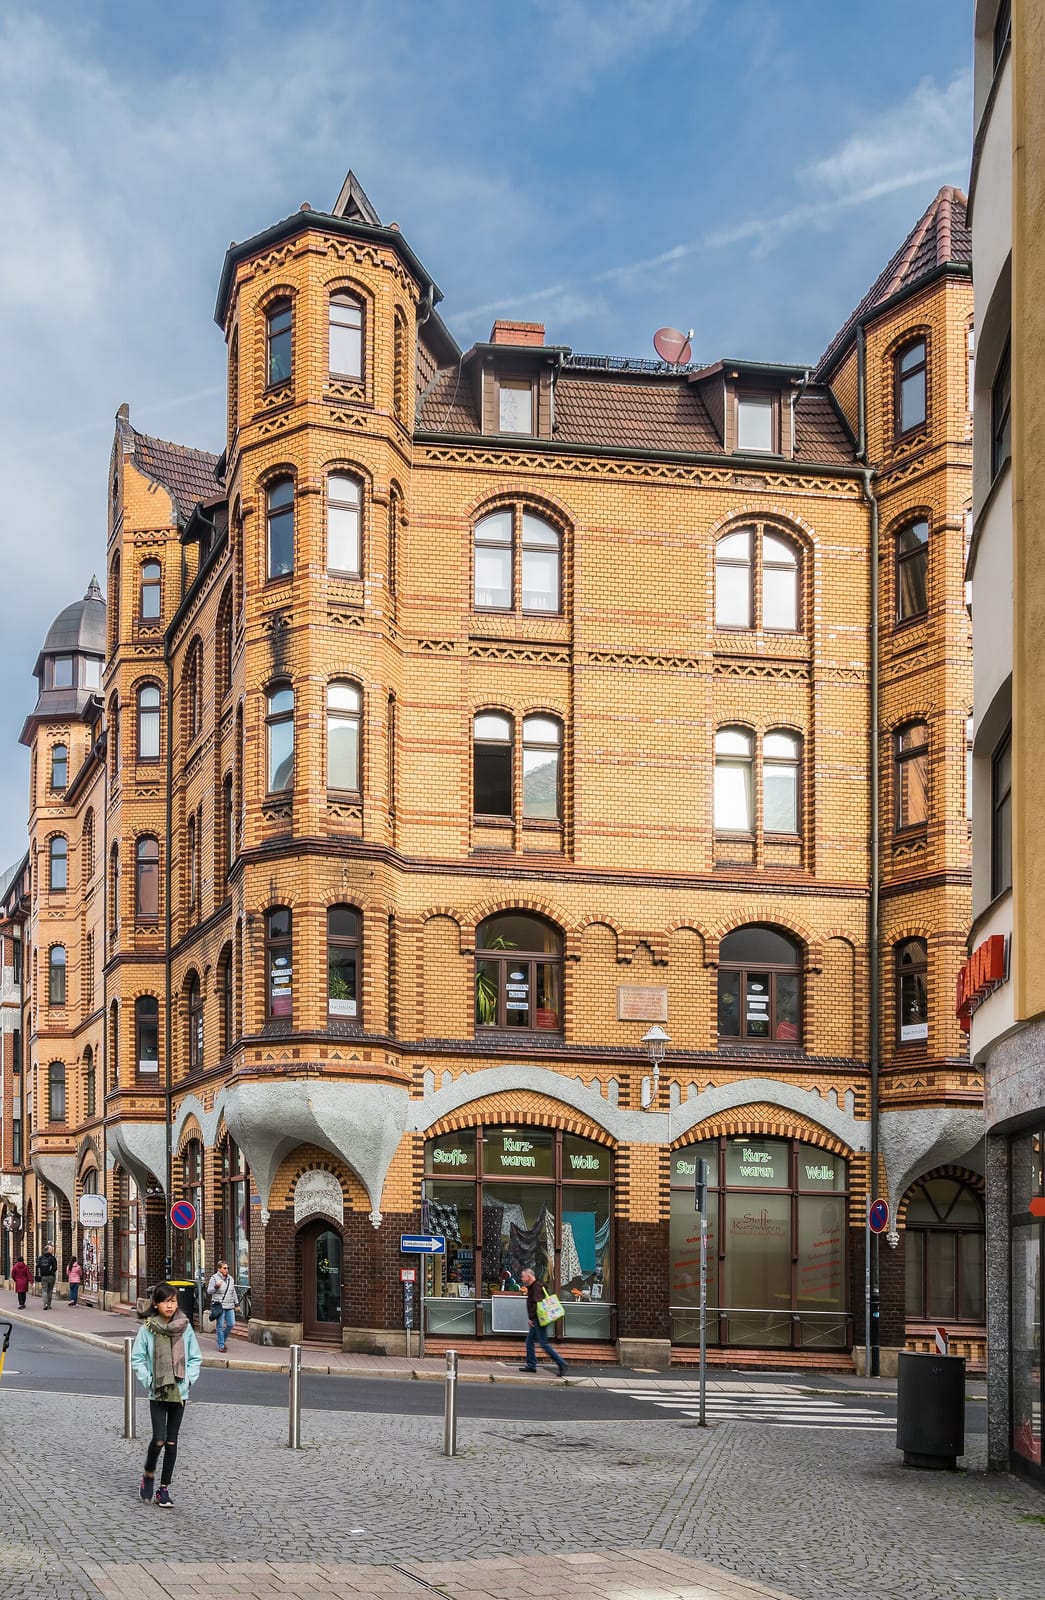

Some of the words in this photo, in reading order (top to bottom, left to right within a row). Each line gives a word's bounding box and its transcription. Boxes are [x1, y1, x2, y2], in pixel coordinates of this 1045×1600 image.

[503, 1137, 534, 1152] Kurz-
[433, 1149, 468, 1166] Stoffe
[500, 1155, 536, 1168] waren
[569, 1154, 600, 1170] Wolle
[742, 1148, 773, 1163] Kurz-
[676, 1160, 710, 1175] Sto
[739, 1166, 774, 1178] waren
[805, 1165, 835, 1180] Wolle
